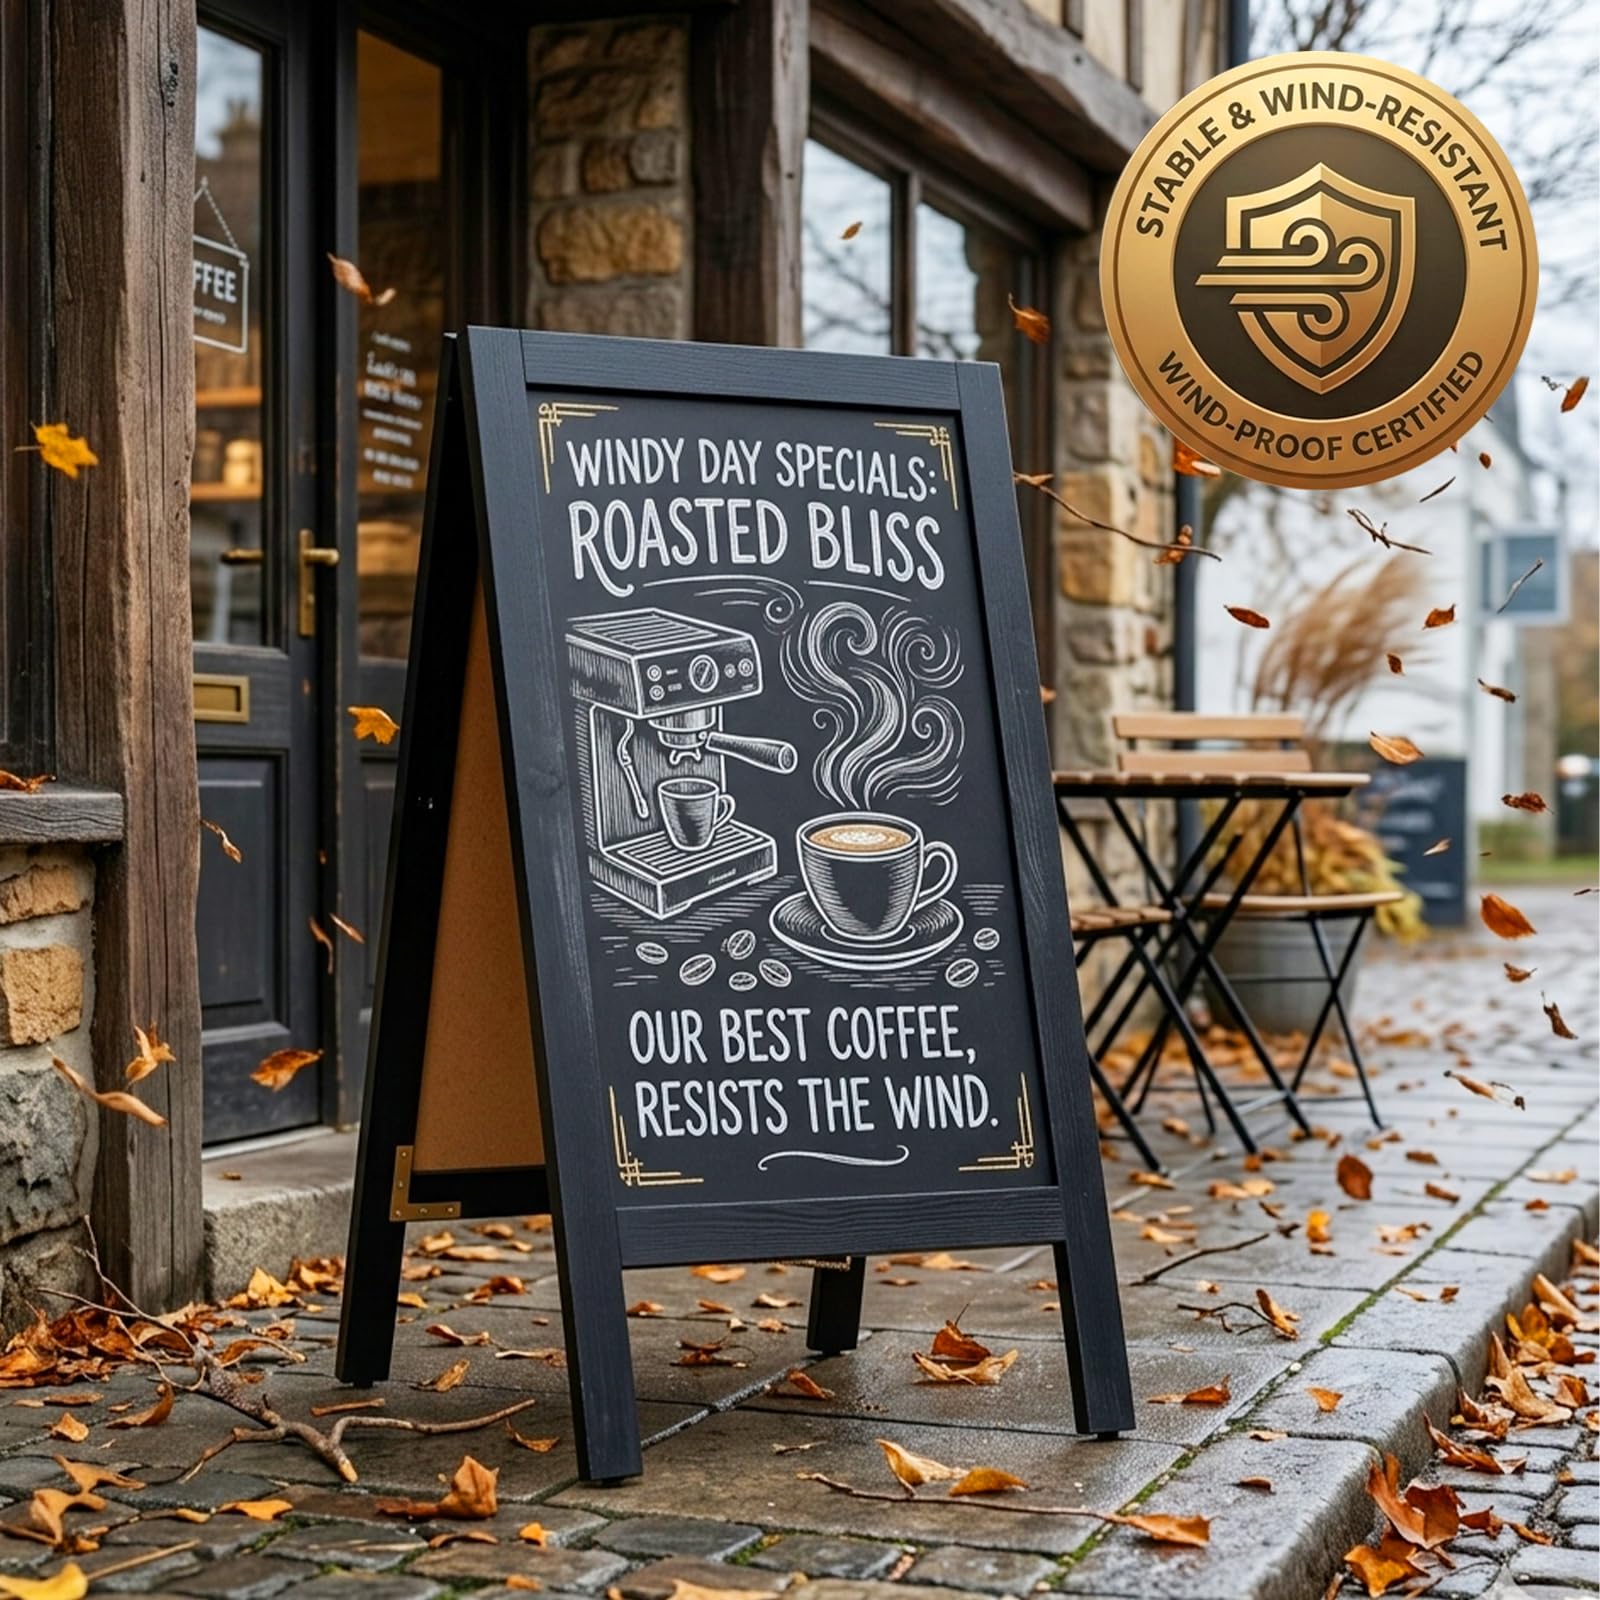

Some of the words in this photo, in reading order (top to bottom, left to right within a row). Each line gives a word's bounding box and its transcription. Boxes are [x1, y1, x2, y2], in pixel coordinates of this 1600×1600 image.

[566, 437, 685, 488] WINDY
[697, 437, 762, 486] DAY
[775, 440, 938, 503] SPECIALS:
[567, 496, 789, 598] ROASTED
[807, 501, 945, 591] BLISS
[629, 1008, 708, 1065] OUR
[719, 1007, 811, 1064] BEST
[827, 1004, 976, 1065] COFFEE,
[634, 1078, 788, 1139] RESISTS
[797, 1076, 875, 1134] THE
[883, 1073, 999, 1130] WIND.
